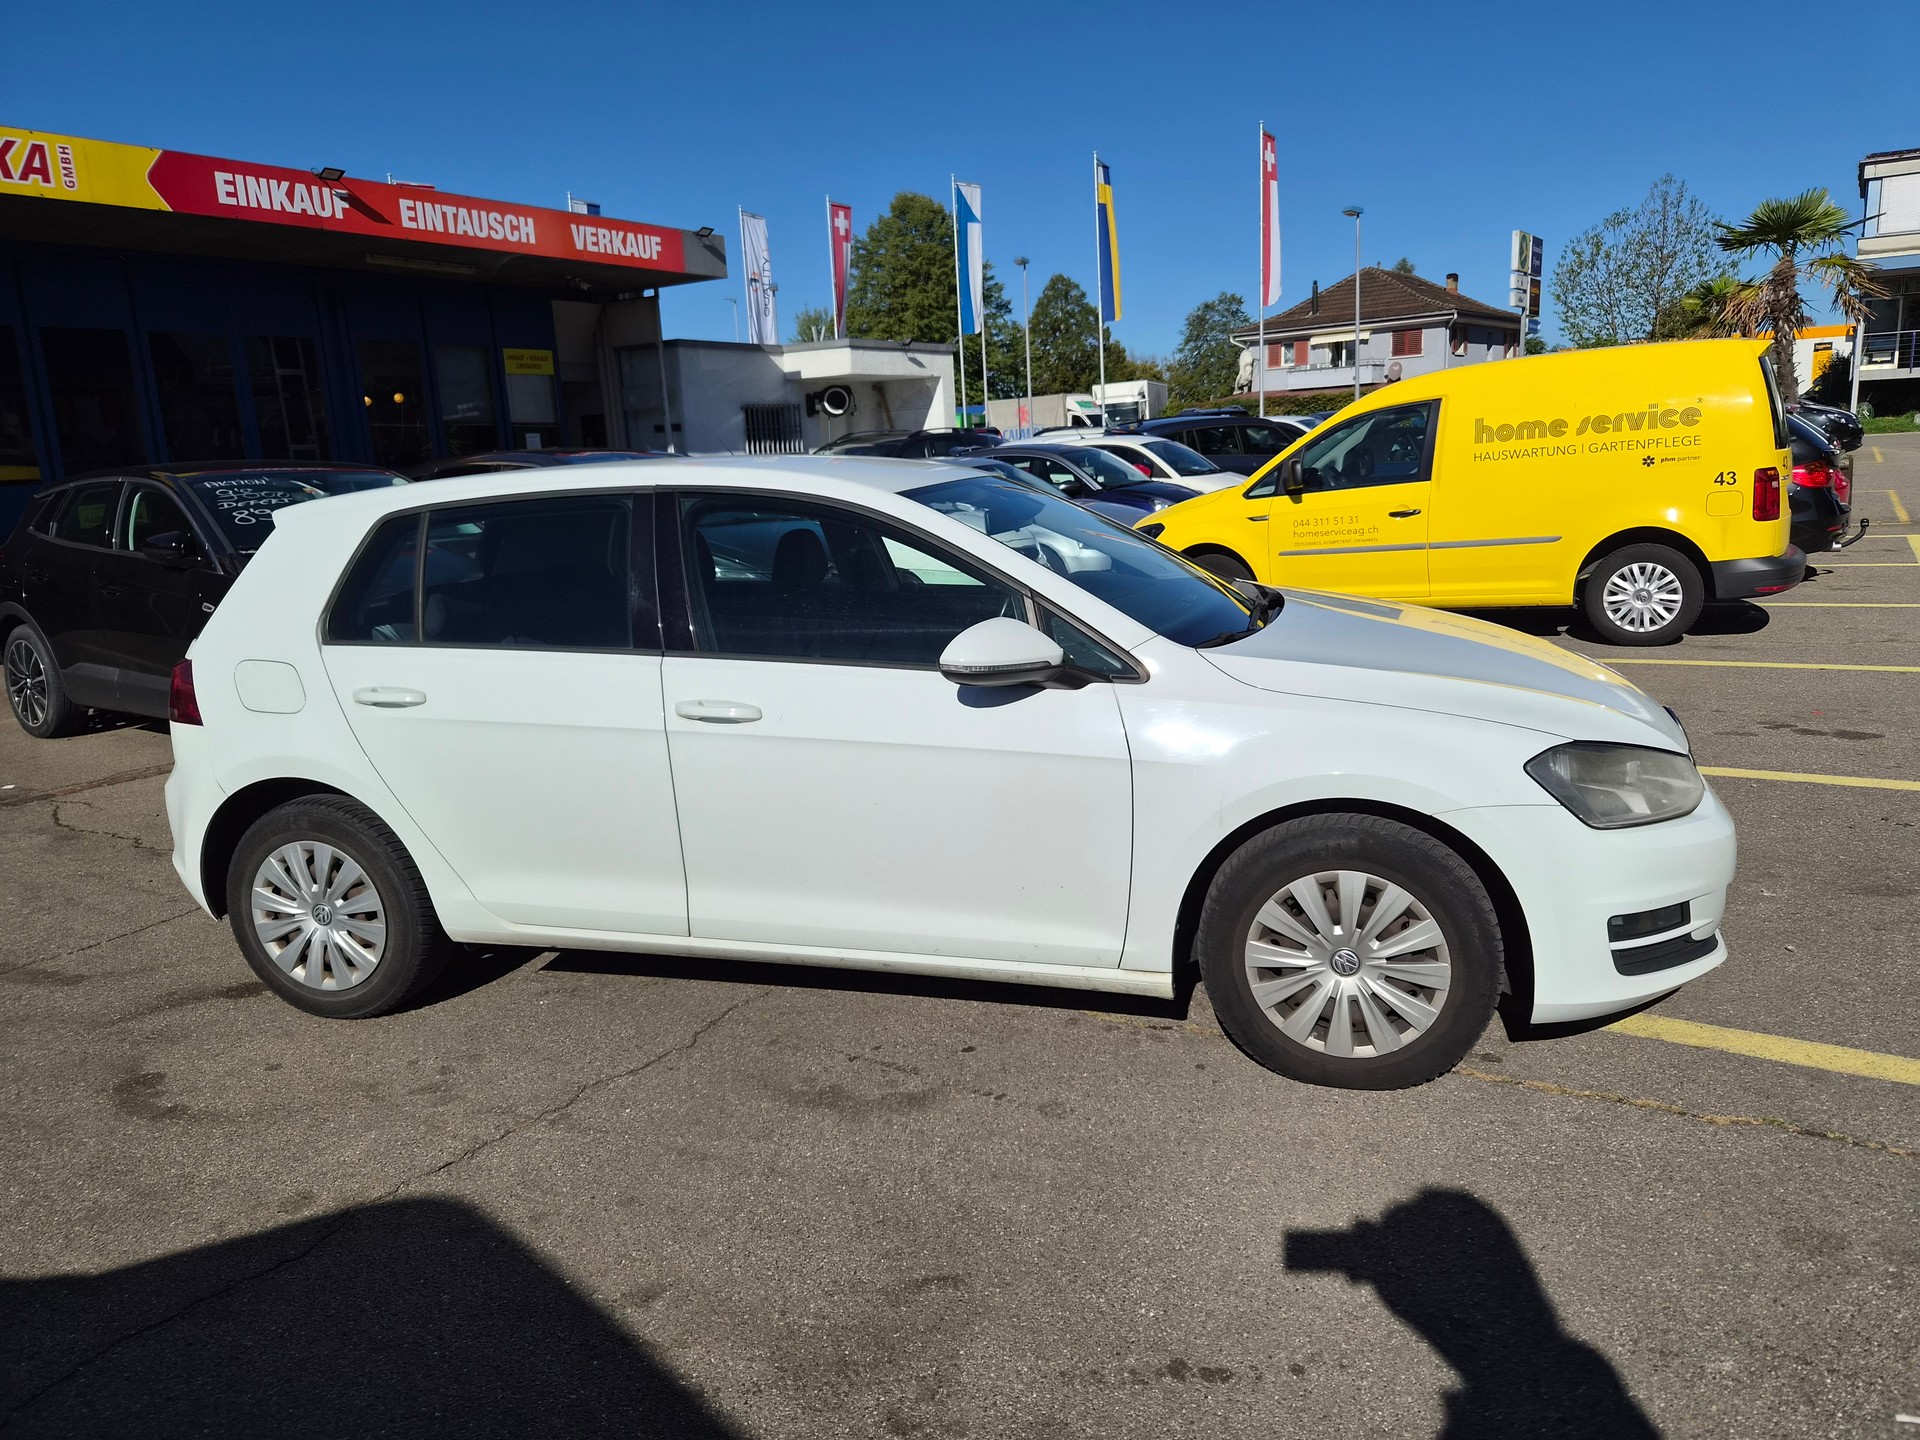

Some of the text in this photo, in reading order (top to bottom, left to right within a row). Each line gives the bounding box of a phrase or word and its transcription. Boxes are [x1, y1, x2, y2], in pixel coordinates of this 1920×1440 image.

[57, 144, 77, 191] GMBH
[214, 171, 662, 260] EINKAUF EINTAUSCH VERKAUF
[1474, 403, 1703, 444] home service
[1474, 444, 1577, 462] HAUSWARTUNG
[1590, 435, 1701, 454] GARTENPFLEGE
[1713, 471, 1737, 486] 43
[1293, 516, 1359, 528] 044 311 51 31
[1293, 525, 1379, 539] homeserviceag.ch
